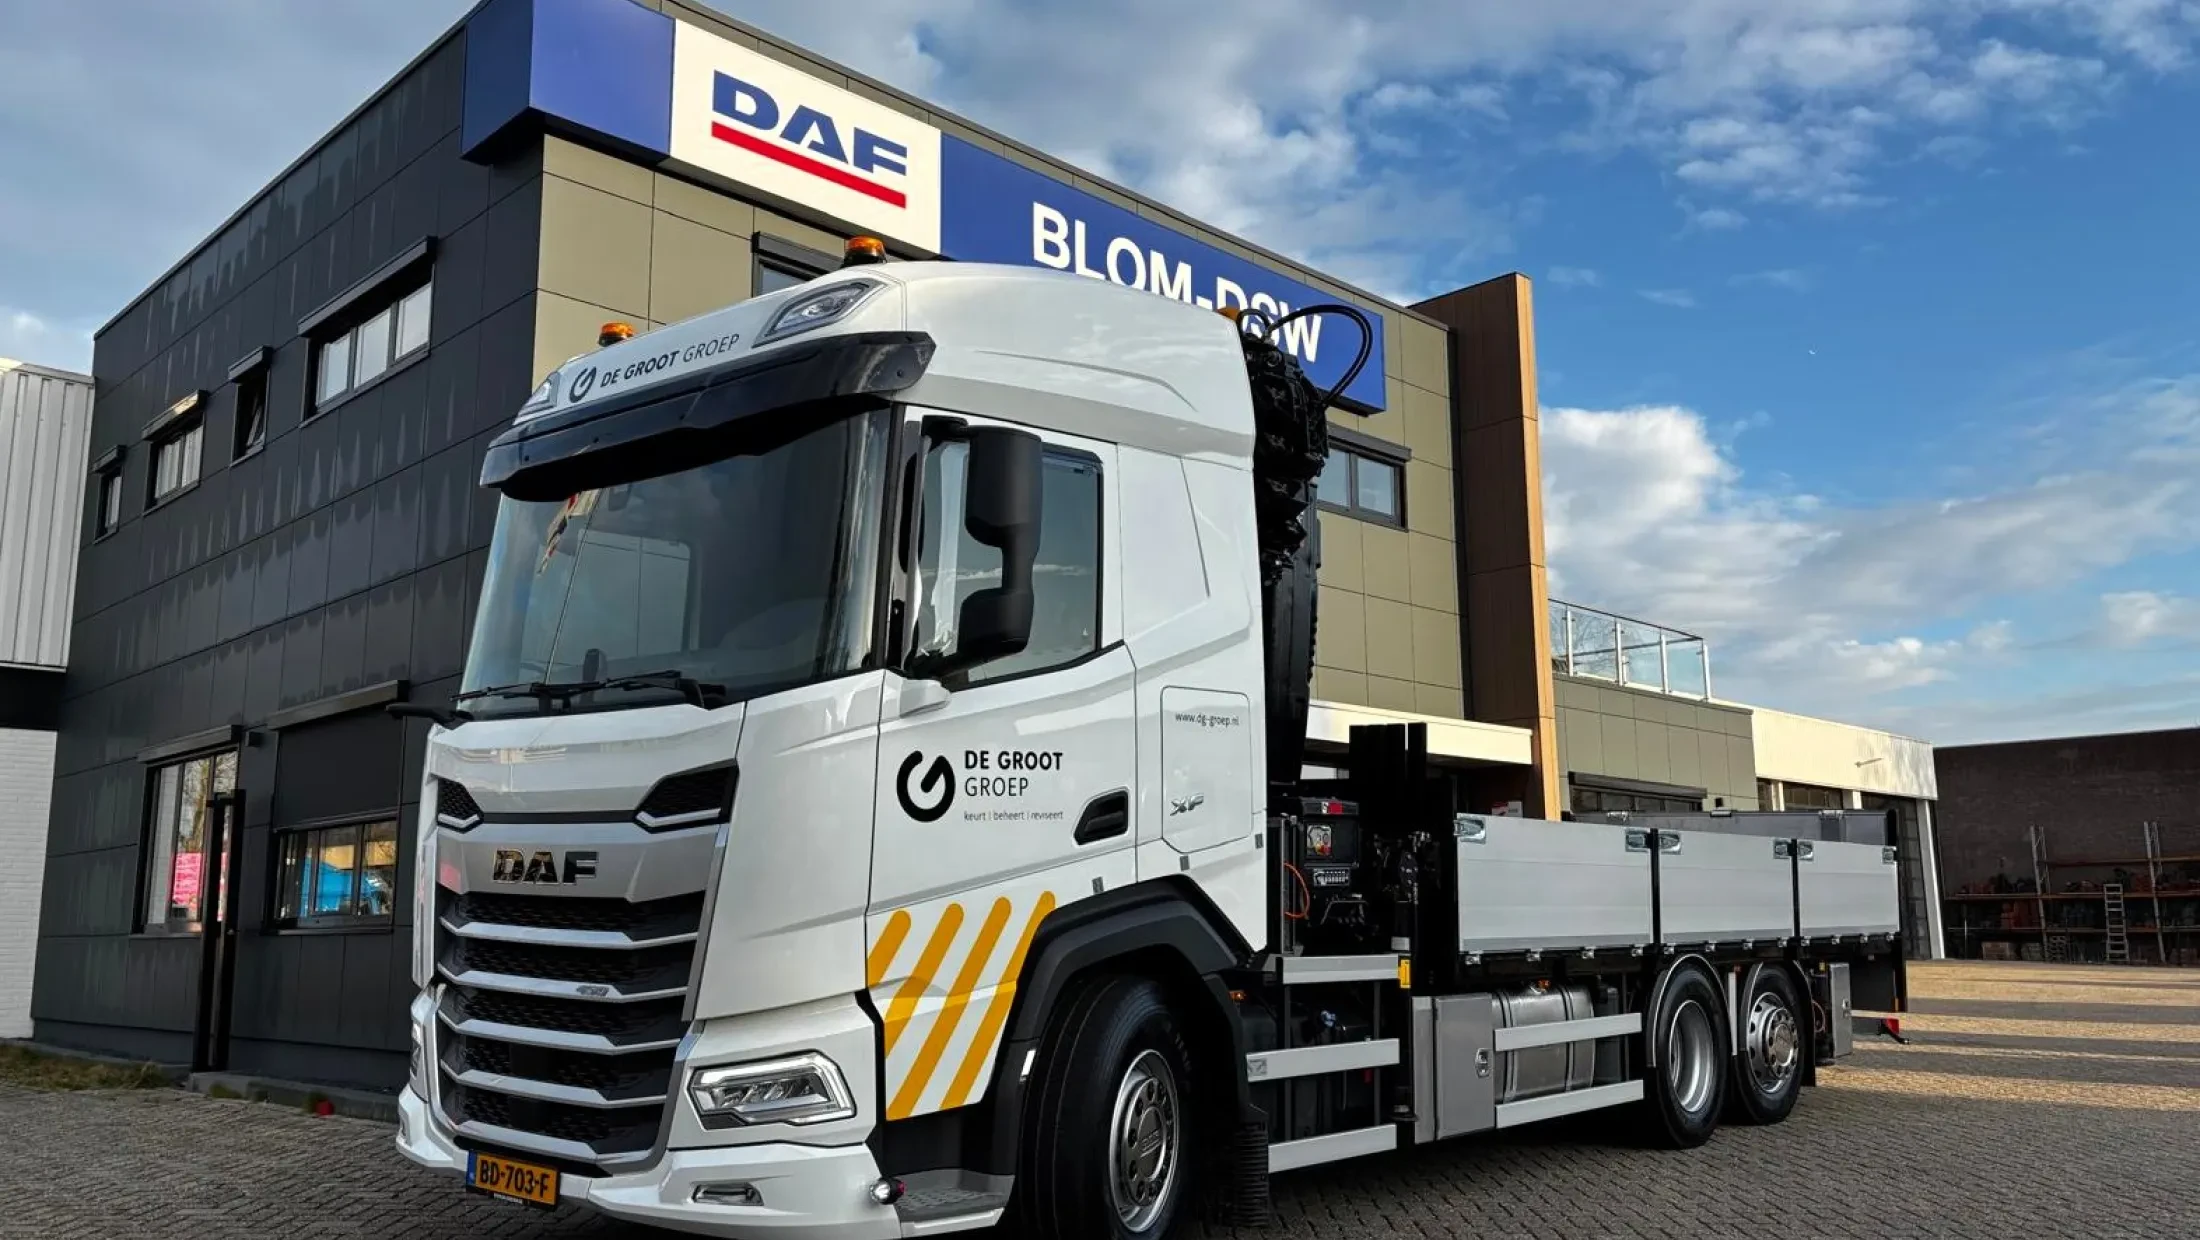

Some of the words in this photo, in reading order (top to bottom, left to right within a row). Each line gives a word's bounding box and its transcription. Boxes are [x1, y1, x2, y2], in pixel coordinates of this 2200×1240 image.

[713, 69, 907, 176] DAF
[1033, 201, 1322, 363] BLOM-DSW
[600, 368, 621, 388] DE
[624, 350, 680, 380] GROOT
[683, 333, 740, 363] GROEP
[1175, 713, 1240, 728] www.dg-groep.nl
[964, 750, 990, 770] DE
[997, 750, 1063, 770] GROOT
[964, 777, 1029, 797] GROEP
[964, 810, 986, 821] keurt
[993, 811, 1024, 821] beheert
[1030, 811, 1063, 821] reviseert
[492, 848, 599, 885] DAF
[480, 1159, 551, 1198] BD-703-F
